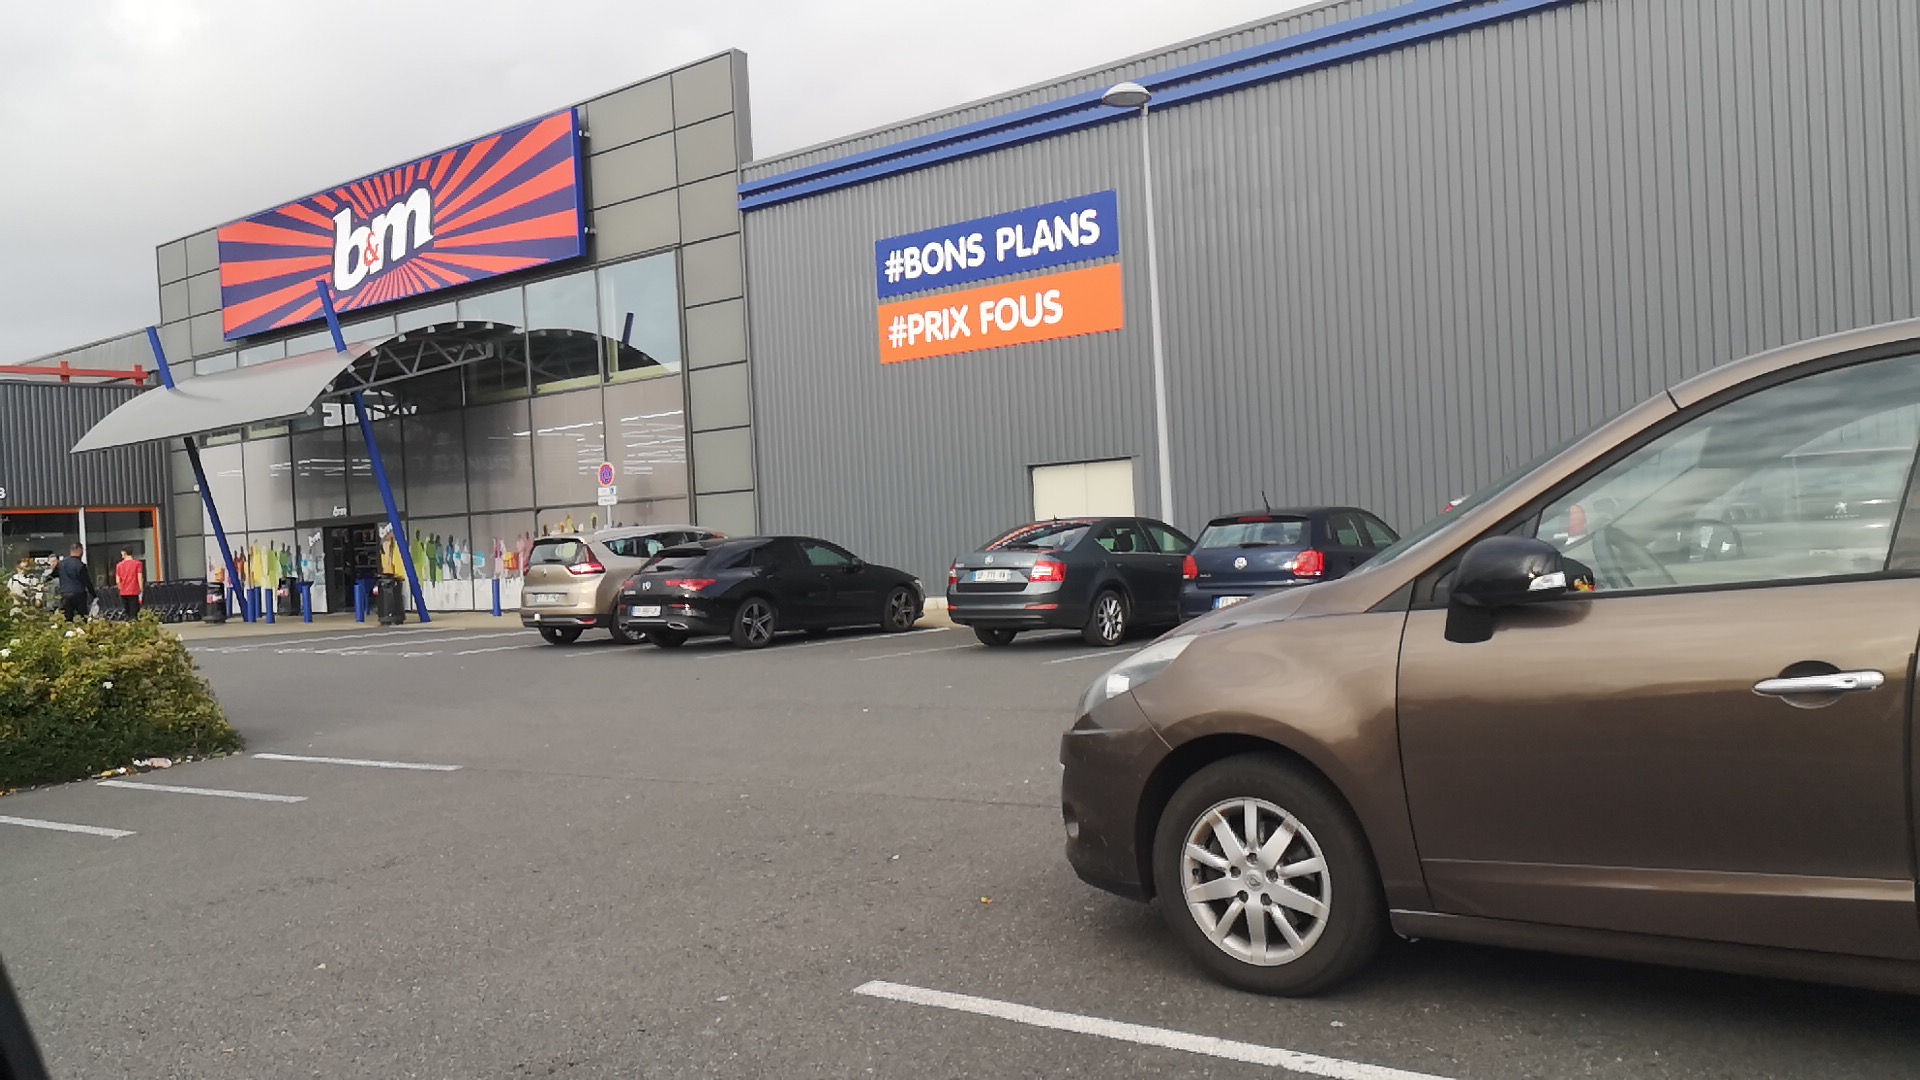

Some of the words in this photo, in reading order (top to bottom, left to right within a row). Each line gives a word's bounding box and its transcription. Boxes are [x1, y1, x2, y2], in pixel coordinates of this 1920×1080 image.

[332, 188, 434, 290] b&m
[884, 233, 986, 283] #BONS
[996, 208, 1100, 262] PLANS
[888, 304, 971, 348] #PRIX
[979, 289, 1064, 334] FOUS
